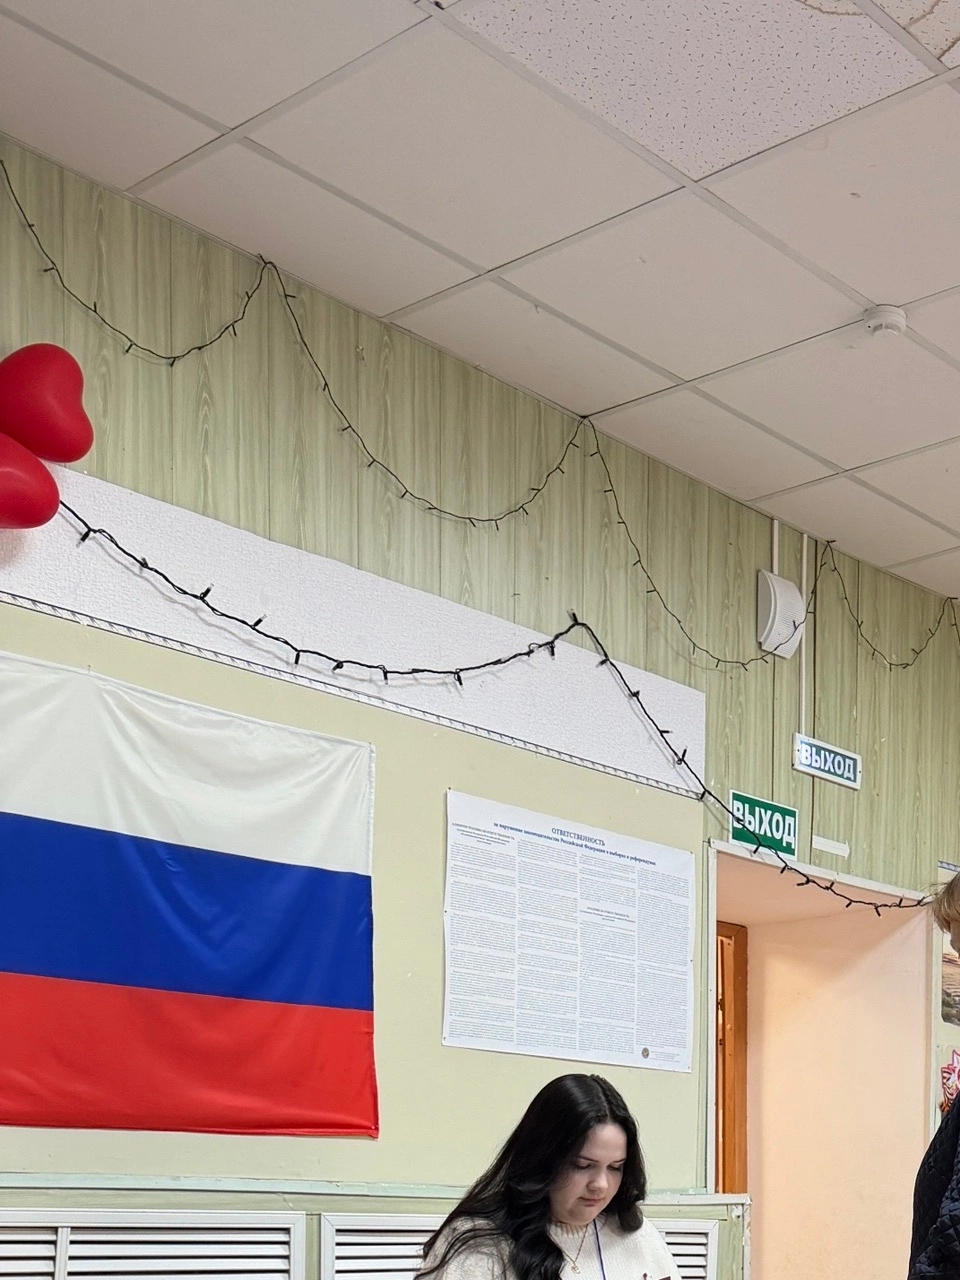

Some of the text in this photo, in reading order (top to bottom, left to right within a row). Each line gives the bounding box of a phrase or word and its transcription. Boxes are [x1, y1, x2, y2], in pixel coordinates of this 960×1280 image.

[800, 743, 855, 781] ВЫХОД
[551, 827, 606, 847] ОТВЕТСТВЕННОСТЬ
[732, 799, 796, 849] ВЫХОД
[560, 837, 584, 850] Российской
[583, 842, 606, 856] Федерации
